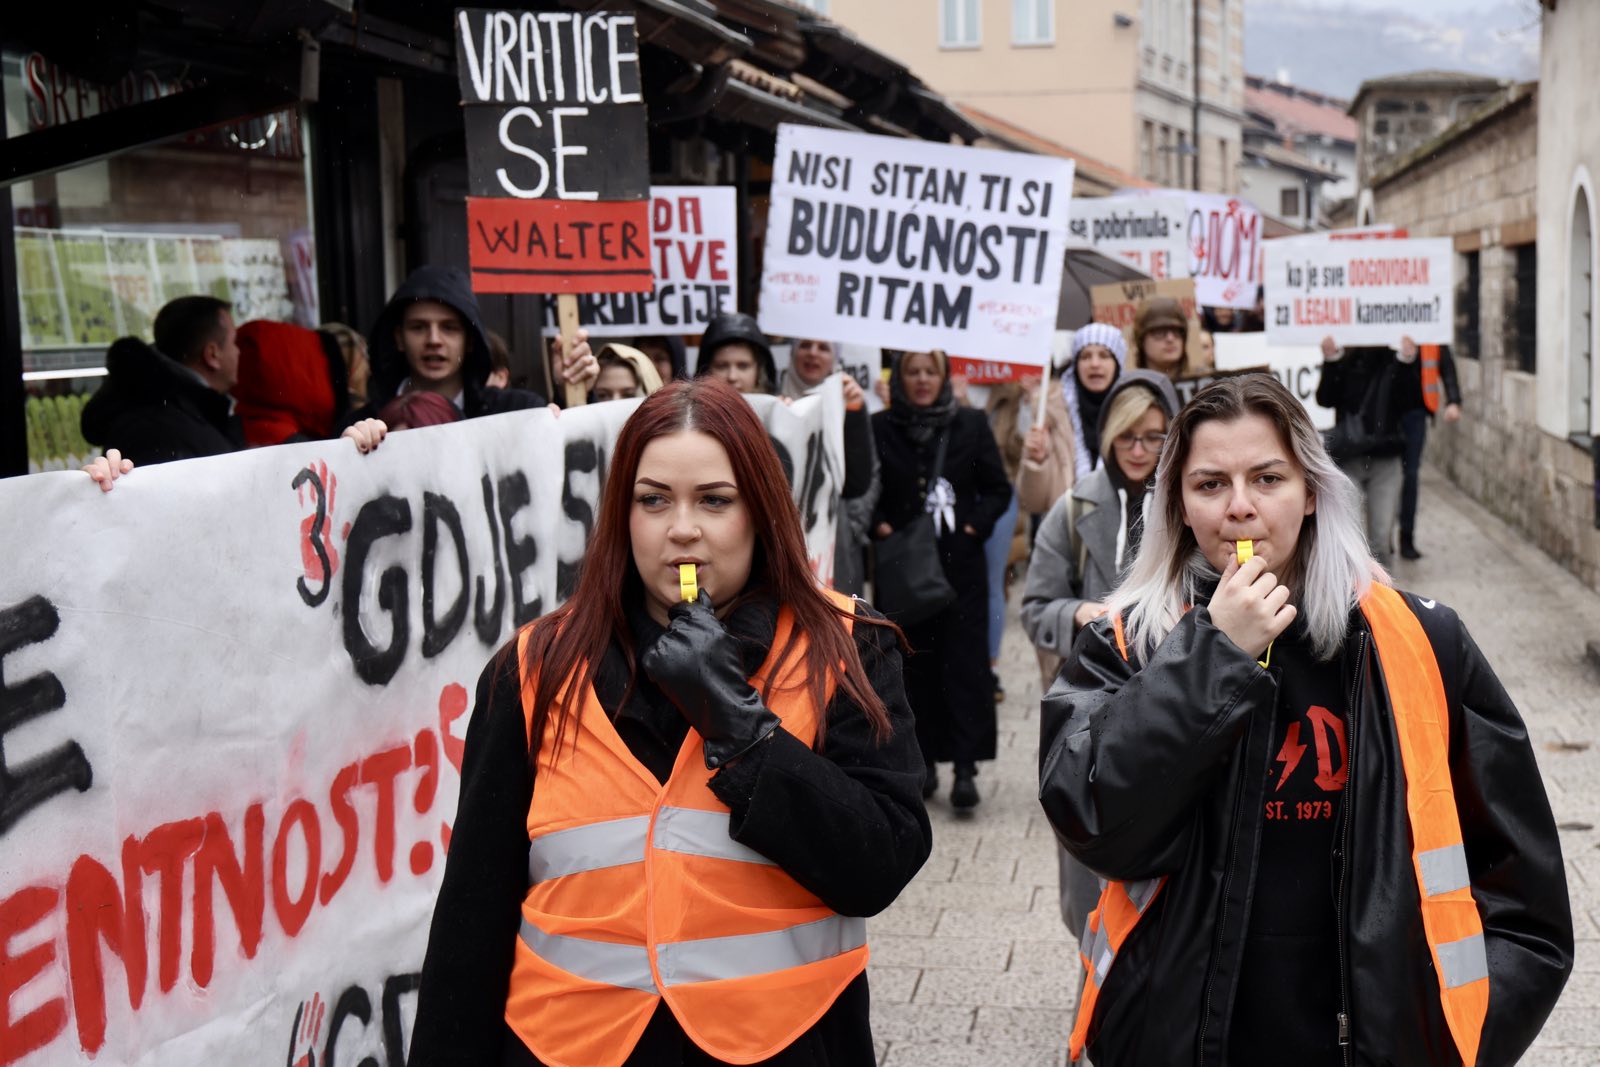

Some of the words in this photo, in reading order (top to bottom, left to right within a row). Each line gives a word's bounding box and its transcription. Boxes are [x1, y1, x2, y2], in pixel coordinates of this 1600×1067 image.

[496, 106, 599, 200] SE
[788, 150, 852, 191] NISI
[872, 162, 971, 212] SITAN,
[980, 174, 1011, 212] TI
[1017, 180, 1053, 217] SI
[477, 220, 645, 261] WALTER
[788, 198, 1049, 285] BUDUĆNOSTI
[836, 271, 973, 330] RITAM
[1286, 259, 1302, 287] ko
[1306, 260, 1318, 293] je
[1322, 265, 1344, 287] sve
[1348, 257, 1430, 288] ODGOVORAN
[1275, 304, 1290, 326] za
[1293, 296, 1353, 326] ILEGALNI
[1356, 295, 1441, 325] kamenolom?
[342, 468, 541, 686] GDJE
[1295, 801, 1332, 820] 1973
